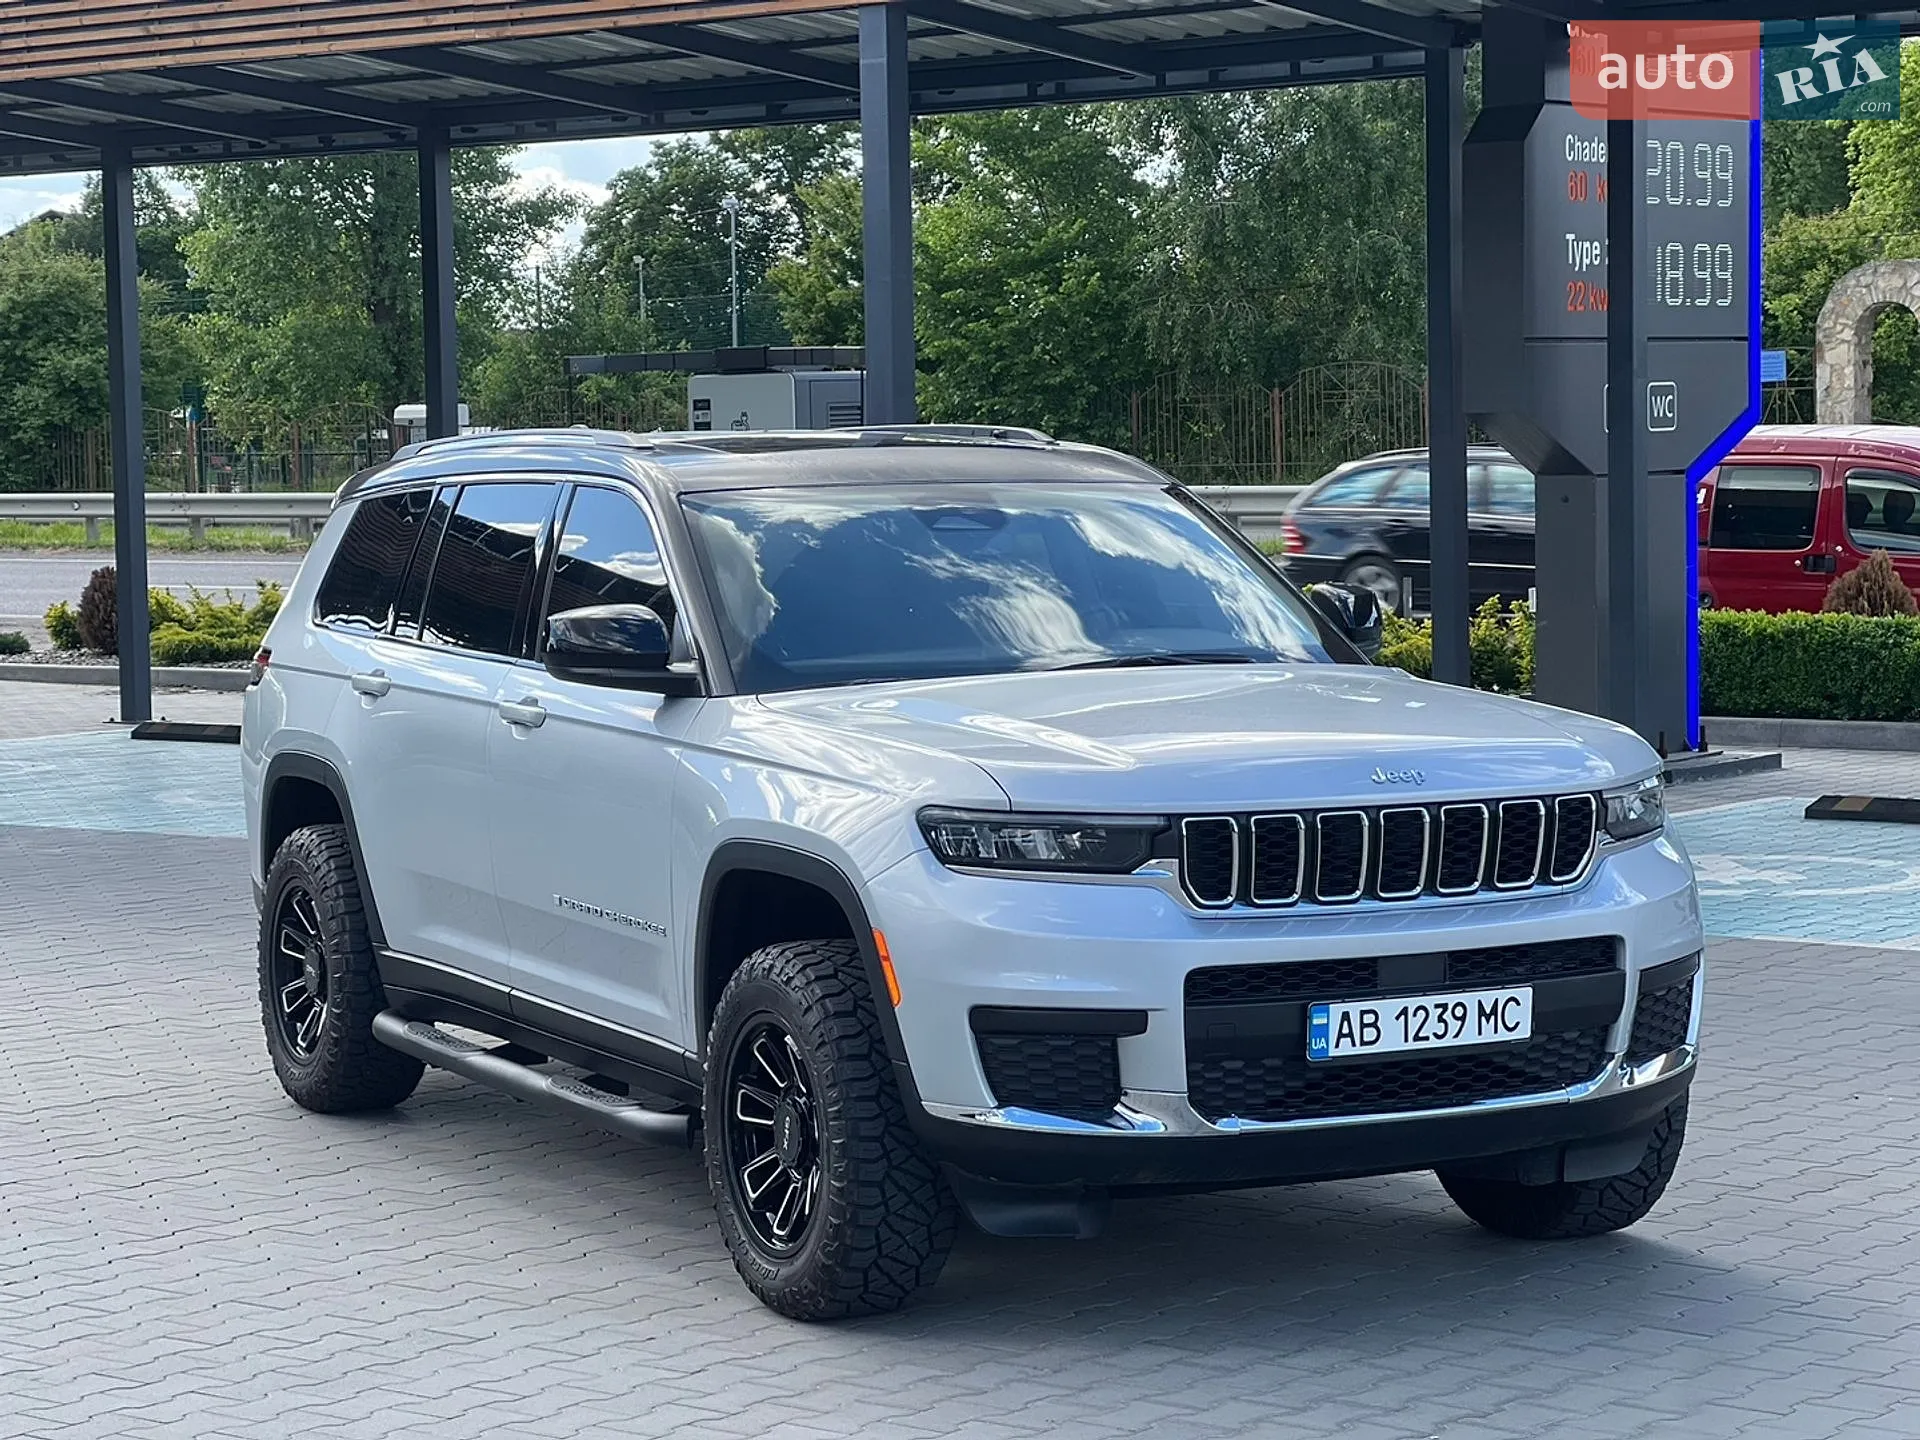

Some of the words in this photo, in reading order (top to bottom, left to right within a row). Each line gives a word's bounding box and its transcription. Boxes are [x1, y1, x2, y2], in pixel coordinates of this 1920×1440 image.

[1565, 134, 1608, 163] Chade
[1567, 169, 1588, 202] 60
[1646, 139, 1733, 207] 20.99
[1565, 233, 1600, 272] Type
[1655, 242, 1733, 306] 18.99
[1566, 279, 1587, 312] 22
[1651, 394, 1674, 418] WC
[1370, 767, 1426, 786] Jeep
[1334, 1008, 1382, 1049] AB
[1394, 1001, 1468, 1044] 1239
[1477, 996, 1522, 1037] MC
[1311, 1036, 1328, 1050] UA
